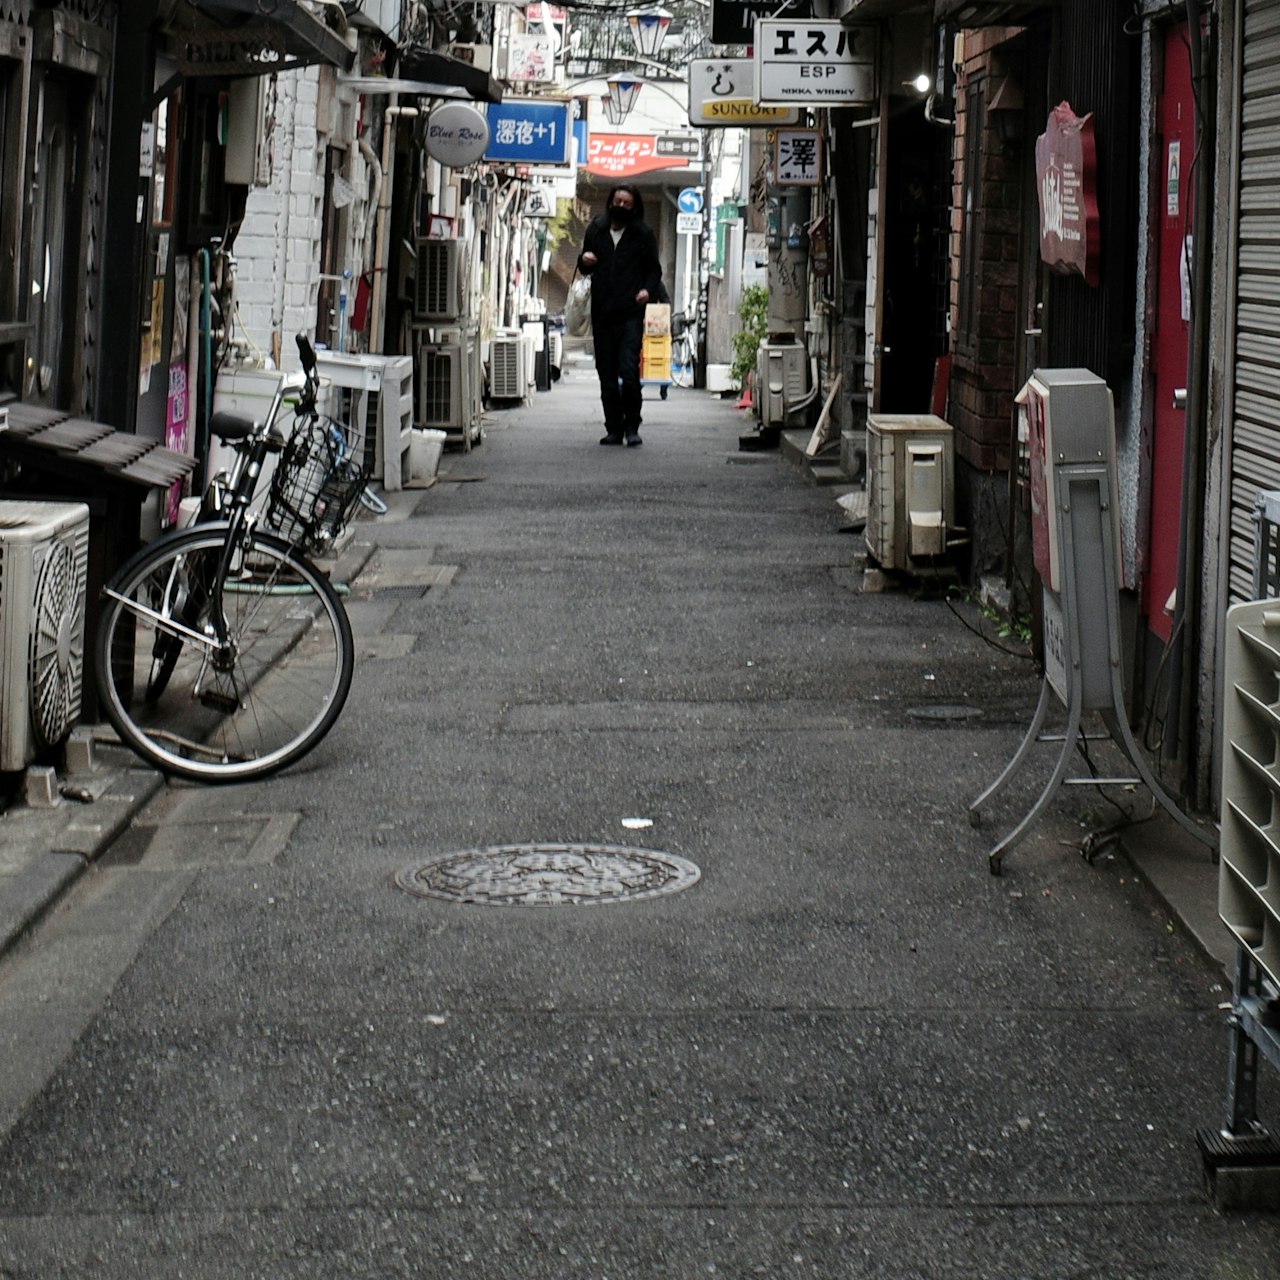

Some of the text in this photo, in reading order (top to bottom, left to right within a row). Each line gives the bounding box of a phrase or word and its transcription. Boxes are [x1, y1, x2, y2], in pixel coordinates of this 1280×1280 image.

[800, 65, 836, 78] ESP
[712, 102, 778, 116] SUNTORY
[429, 124, 484, 141] Blue Rose
[496, 119, 556, 146] 深夜+1
[780, 138, 816, 174] 澤
